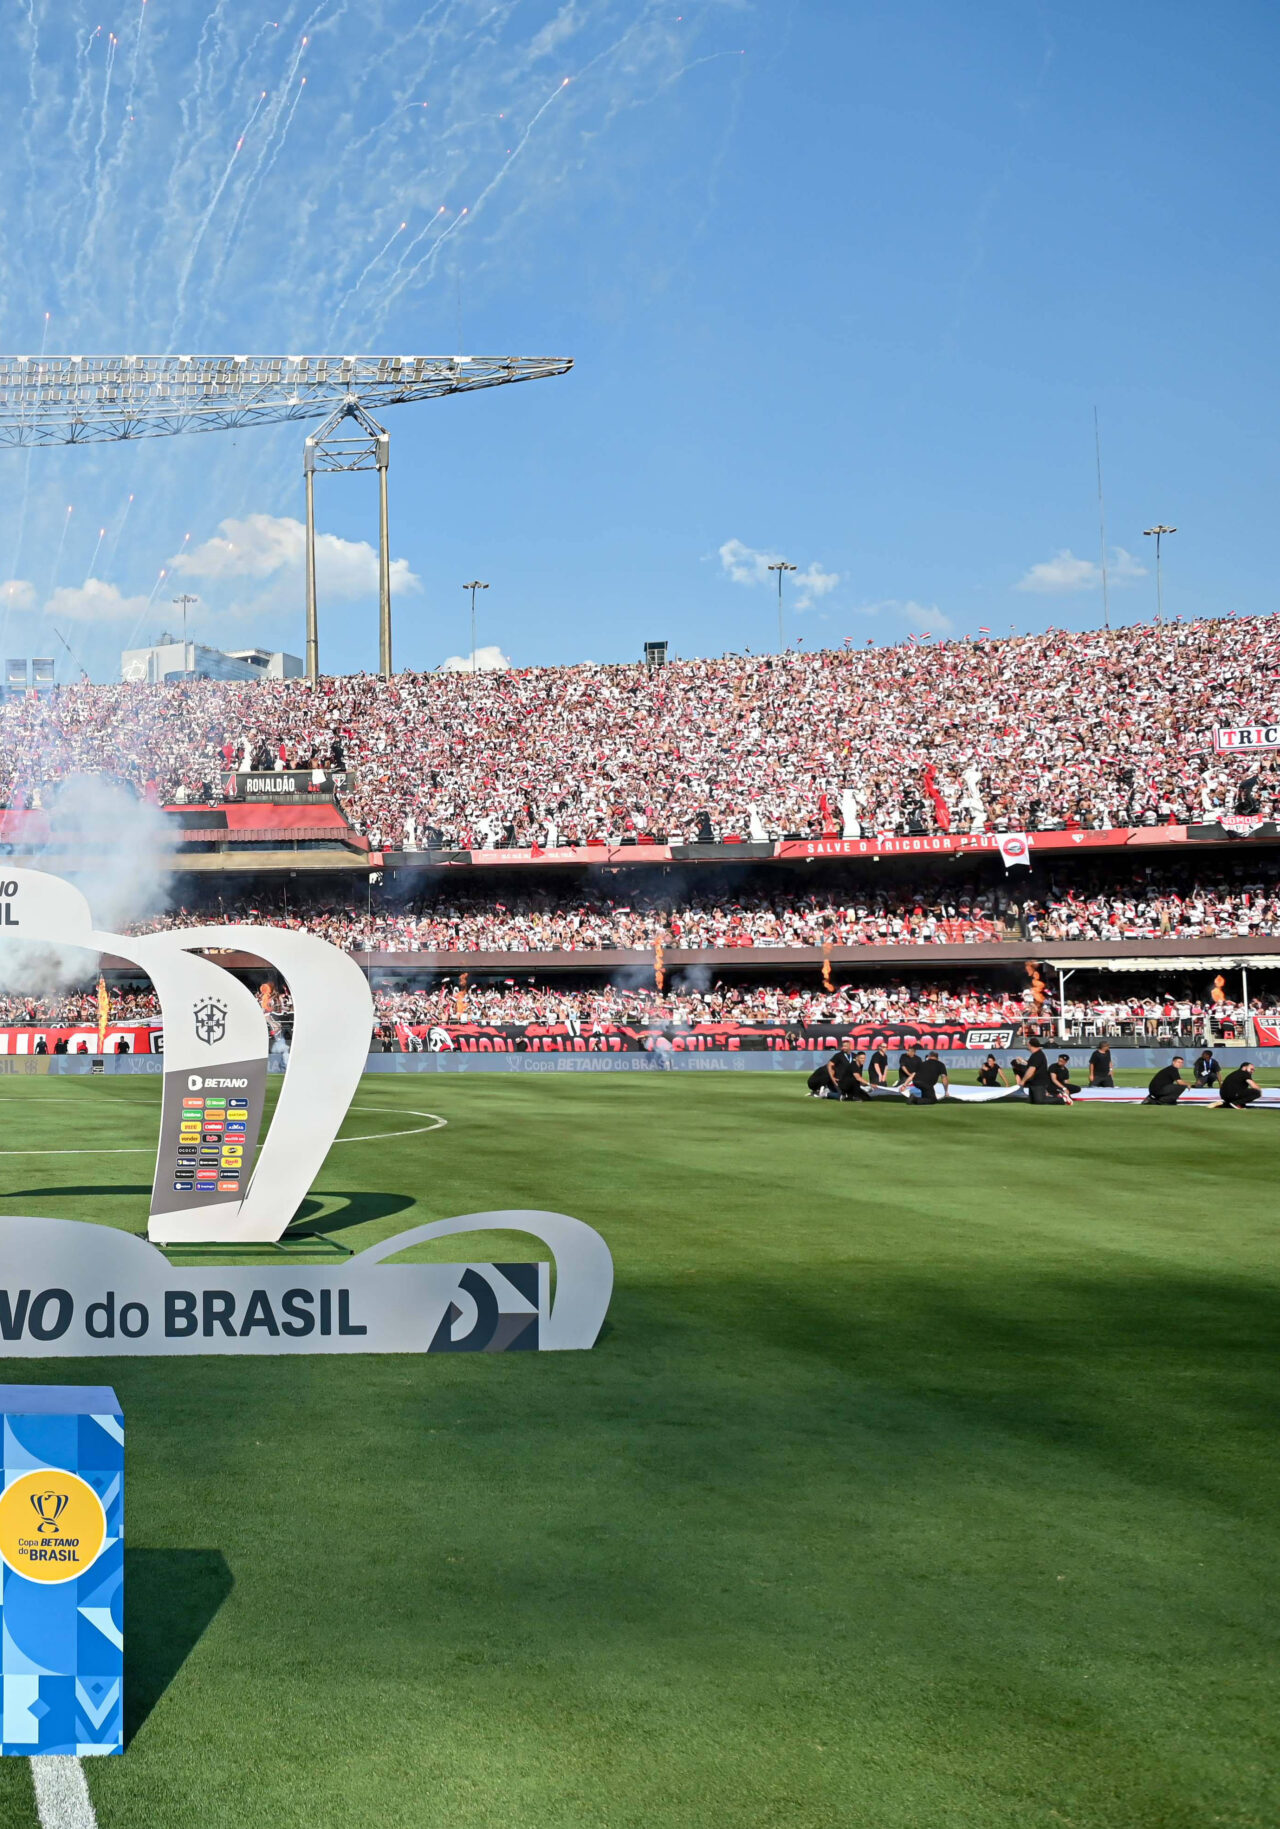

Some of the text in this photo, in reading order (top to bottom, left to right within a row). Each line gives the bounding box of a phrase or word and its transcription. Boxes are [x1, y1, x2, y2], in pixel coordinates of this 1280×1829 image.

[1222, 727, 1279, 746] TRIC
[246, 775, 296, 792] RONALDÃO
[1221, 815, 1260, 825] SOMOS
[807, 835, 1036, 854] SALVE O TRICOLOR PAULA
[970, 1033, 1008, 1043] SPFC
[146, 1061, 162, 1073] Co
[524, 1058, 555, 1072] Copa
[557, 1058, 612, 1071] BETANO
[614, 1058, 630, 1071] do
[687, 1057, 729, 1070] FINAL
[203, 1077, 249, 1089] BETANO
[85, 1291, 149, 1339] do
[164, 1287, 368, 1339] BRASIL
[18, 1538, 80, 1547] Copa BETANO
[18, 1547, 80, 1562] do BRASIL
